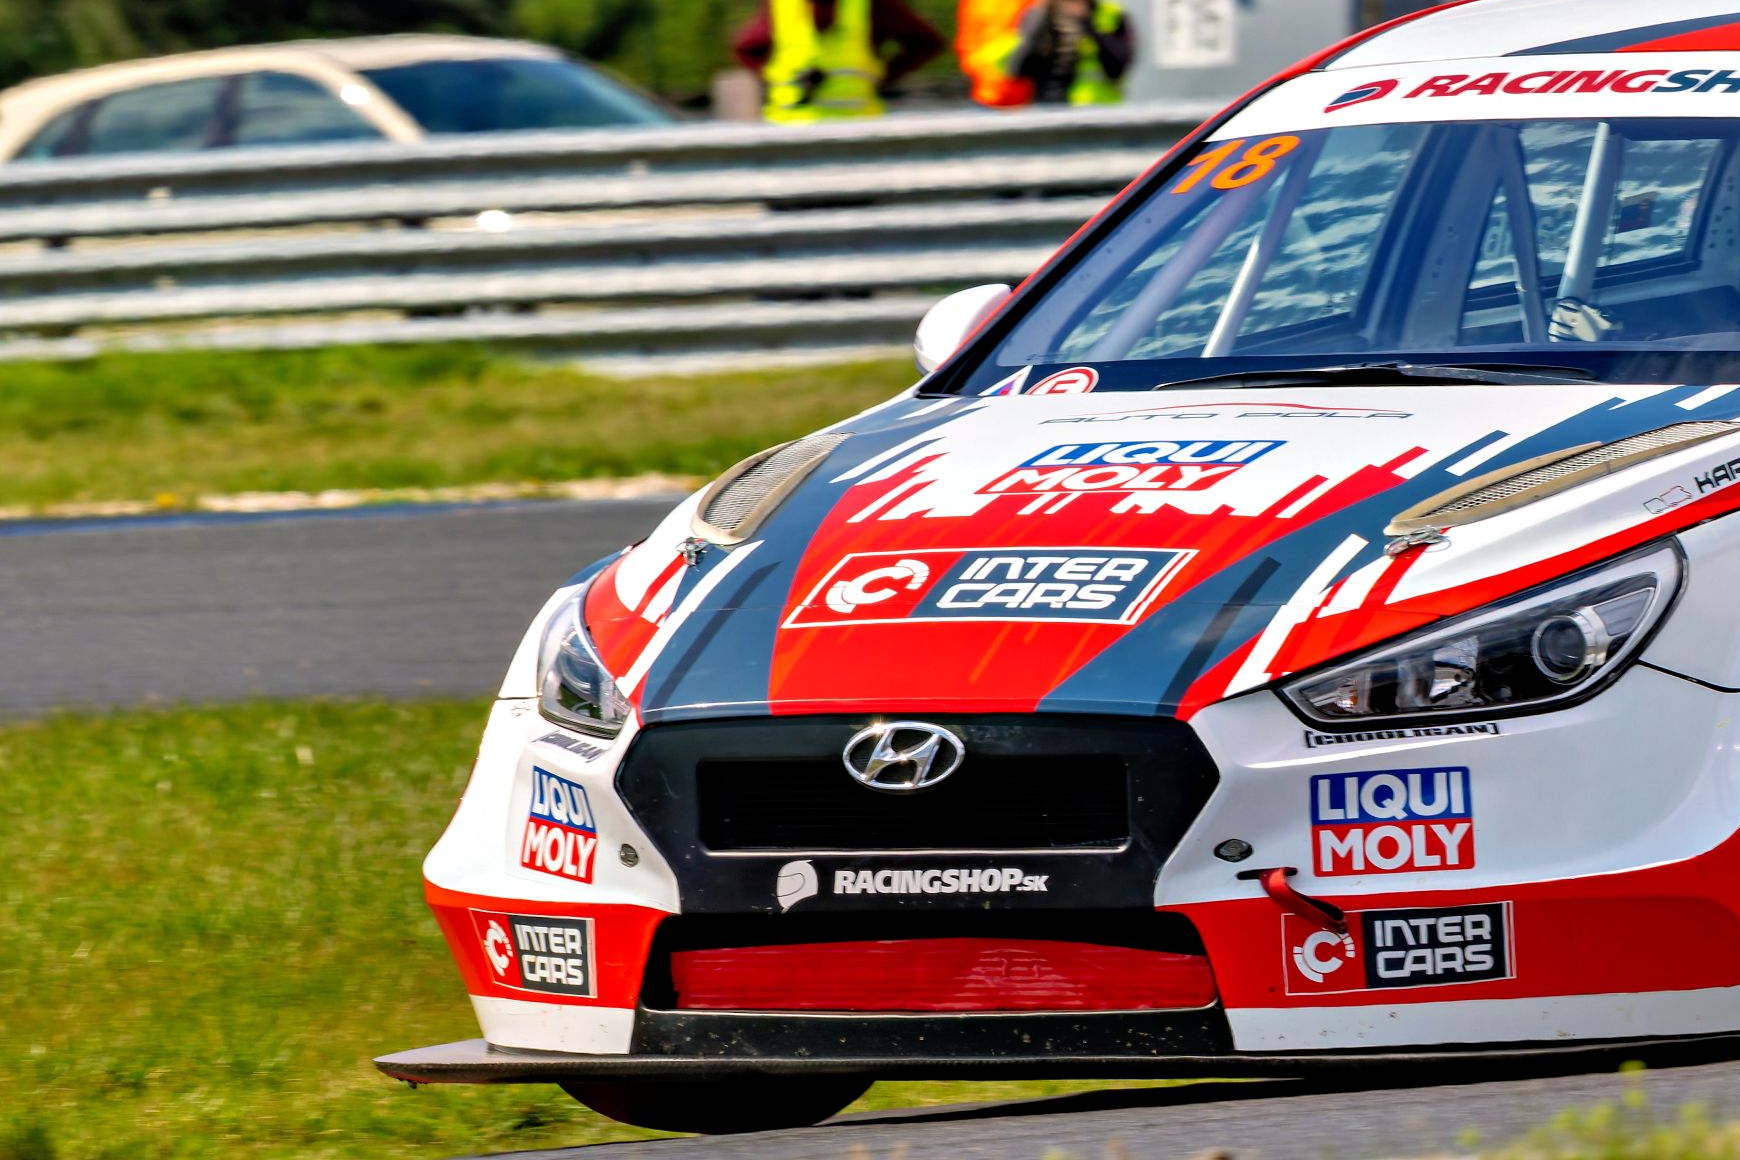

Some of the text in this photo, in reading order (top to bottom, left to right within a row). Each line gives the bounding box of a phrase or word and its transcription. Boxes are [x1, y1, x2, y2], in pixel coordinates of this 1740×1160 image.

[1170, 135, 1301, 194] 18
[1038, 411, 1416, 425] AUTO POLA
[1041, 441, 1275, 465] LIQUI
[987, 465, 1242, 492] MOLY
[958, 556, 1149, 582] INTER
[936, 582, 1127, 609] CARS
[532, 770, 593, 829] LIQUI
[1317, 771, 1466, 821] LIQUI
[521, 821, 598, 878] MOLY
[1319, 822, 1472, 872] MOLY
[514, 923, 583, 955] INTER
[1373, 913, 1492, 947] INTER
[521, 955, 584, 986] CARS
[1376, 943, 1495, 979] CARS
